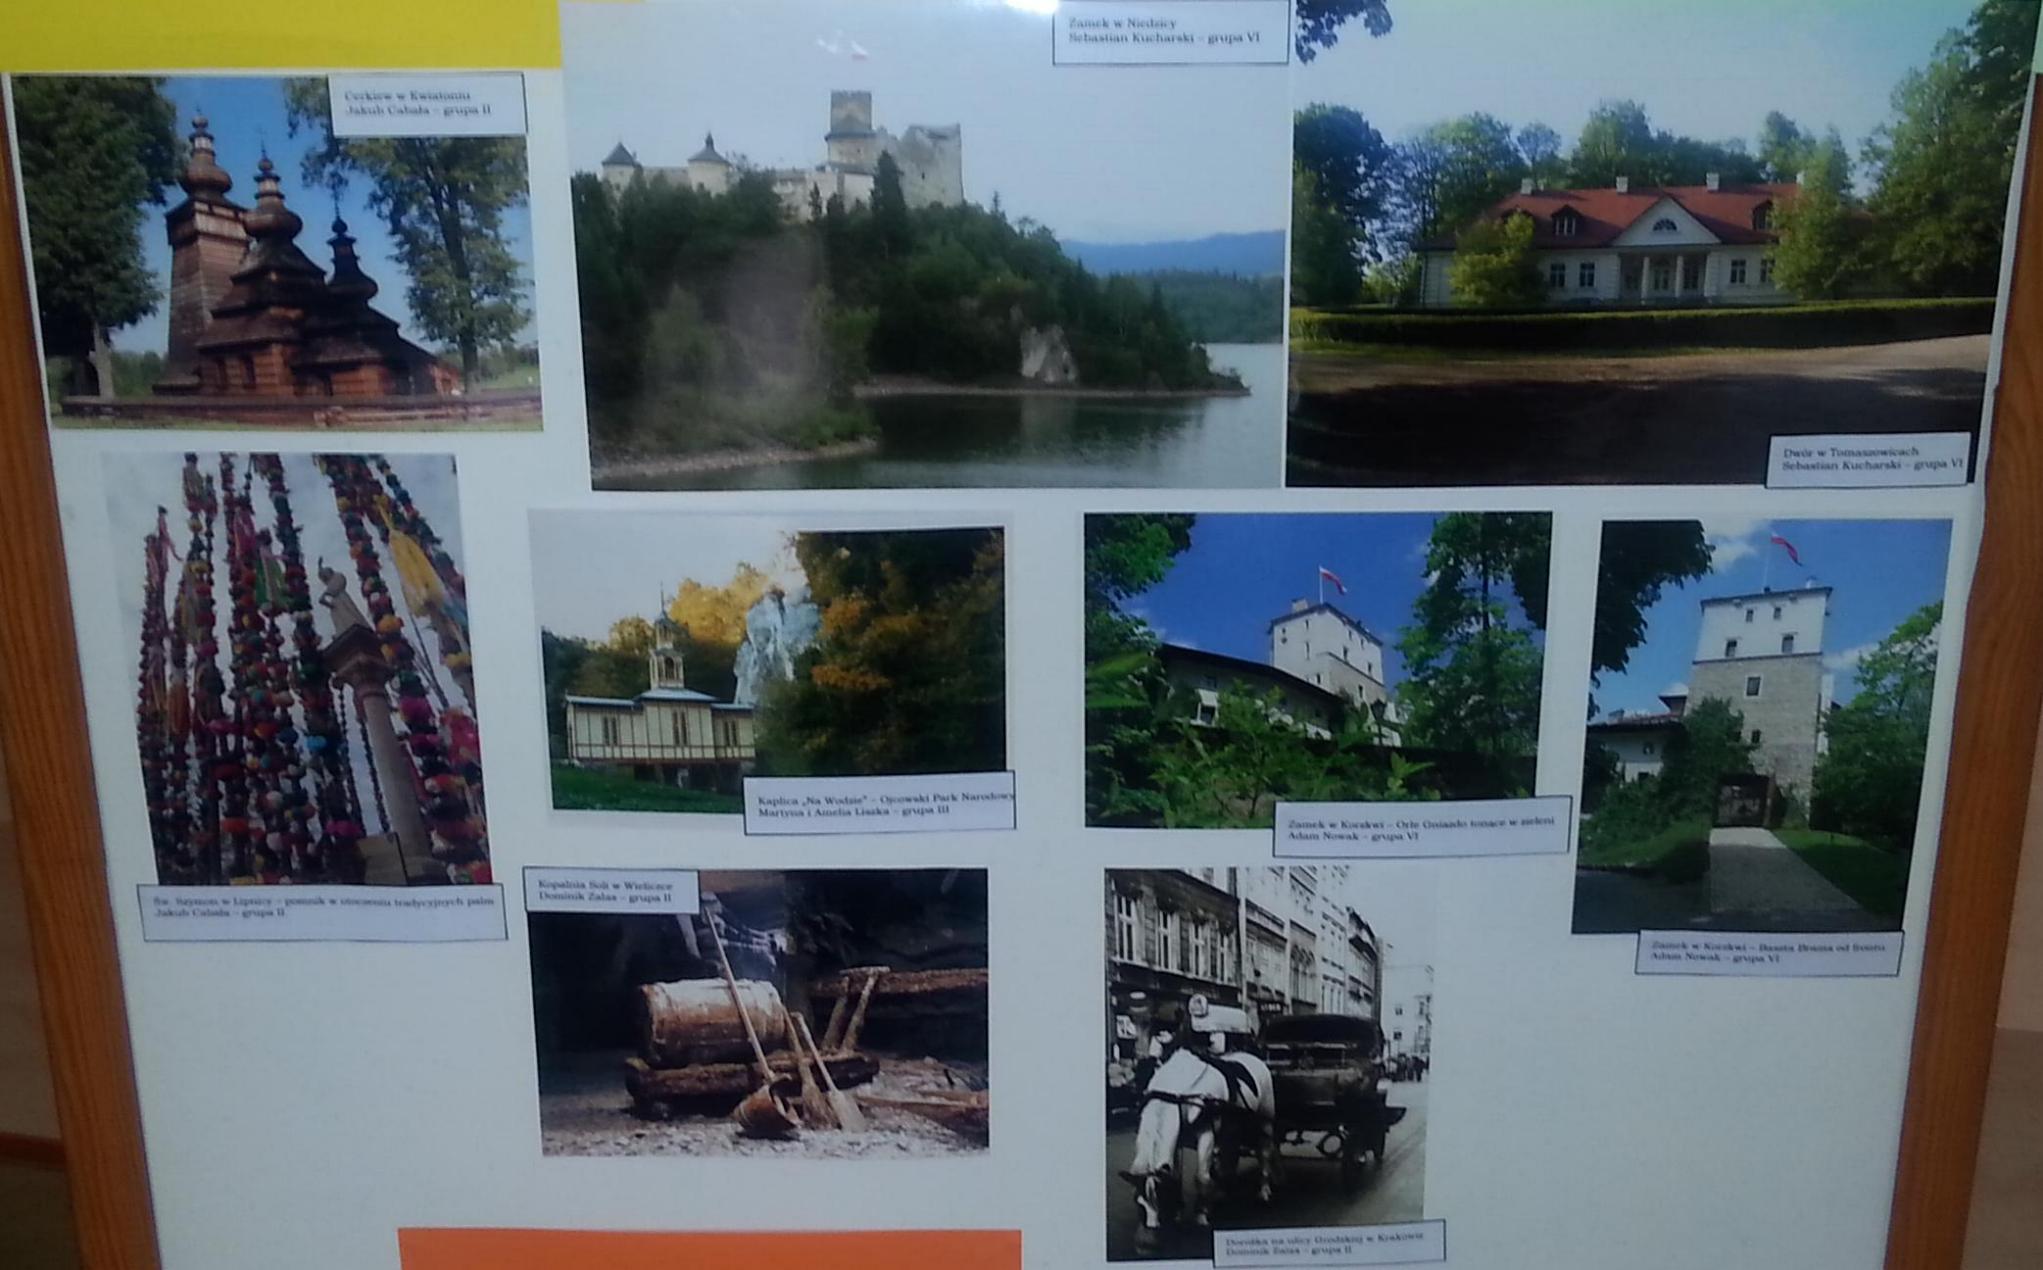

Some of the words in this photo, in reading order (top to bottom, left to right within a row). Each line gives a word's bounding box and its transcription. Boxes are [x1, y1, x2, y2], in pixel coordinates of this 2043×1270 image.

[1113, 20, 1122, 28] w
[1069, 33, 1128, 43] Sebastian
[1132, 32, 1195, 43] Kucharski
[1207, 35, 1243, 45] grupa
[1246, 32, 1261, 43] VI
[396, 92, 406, 100] w
[443, 106, 479, 117] grupa
[482, 104, 491, 114] II
[1782, 460, 1839, 471] Sebastian
[1842, 458, 1902, 470] Kucharski
[1913, 459, 1947, 471] grupa
[1950, 457, 1963, 468] VI
[758, 796, 799, 807] Kaplica
[932, 793, 957, 803] Park
[902, 808, 935, 818] grupa
[1288, 831, 1320, 841] Adam
[1323, 831, 1360, 841] Nowak
[1371, 832, 1404, 842] grupa
[1406, 831, 1419, 841] VI
[612, 882, 621, 890] w
[629, 894, 661, 905] grupa
[664, 893, 672, 903] II
[241, 910, 275, 920] grupa
[1733, 953, 1765, 964] grupa
[1311, 1246, 1342, 1256] grupa
